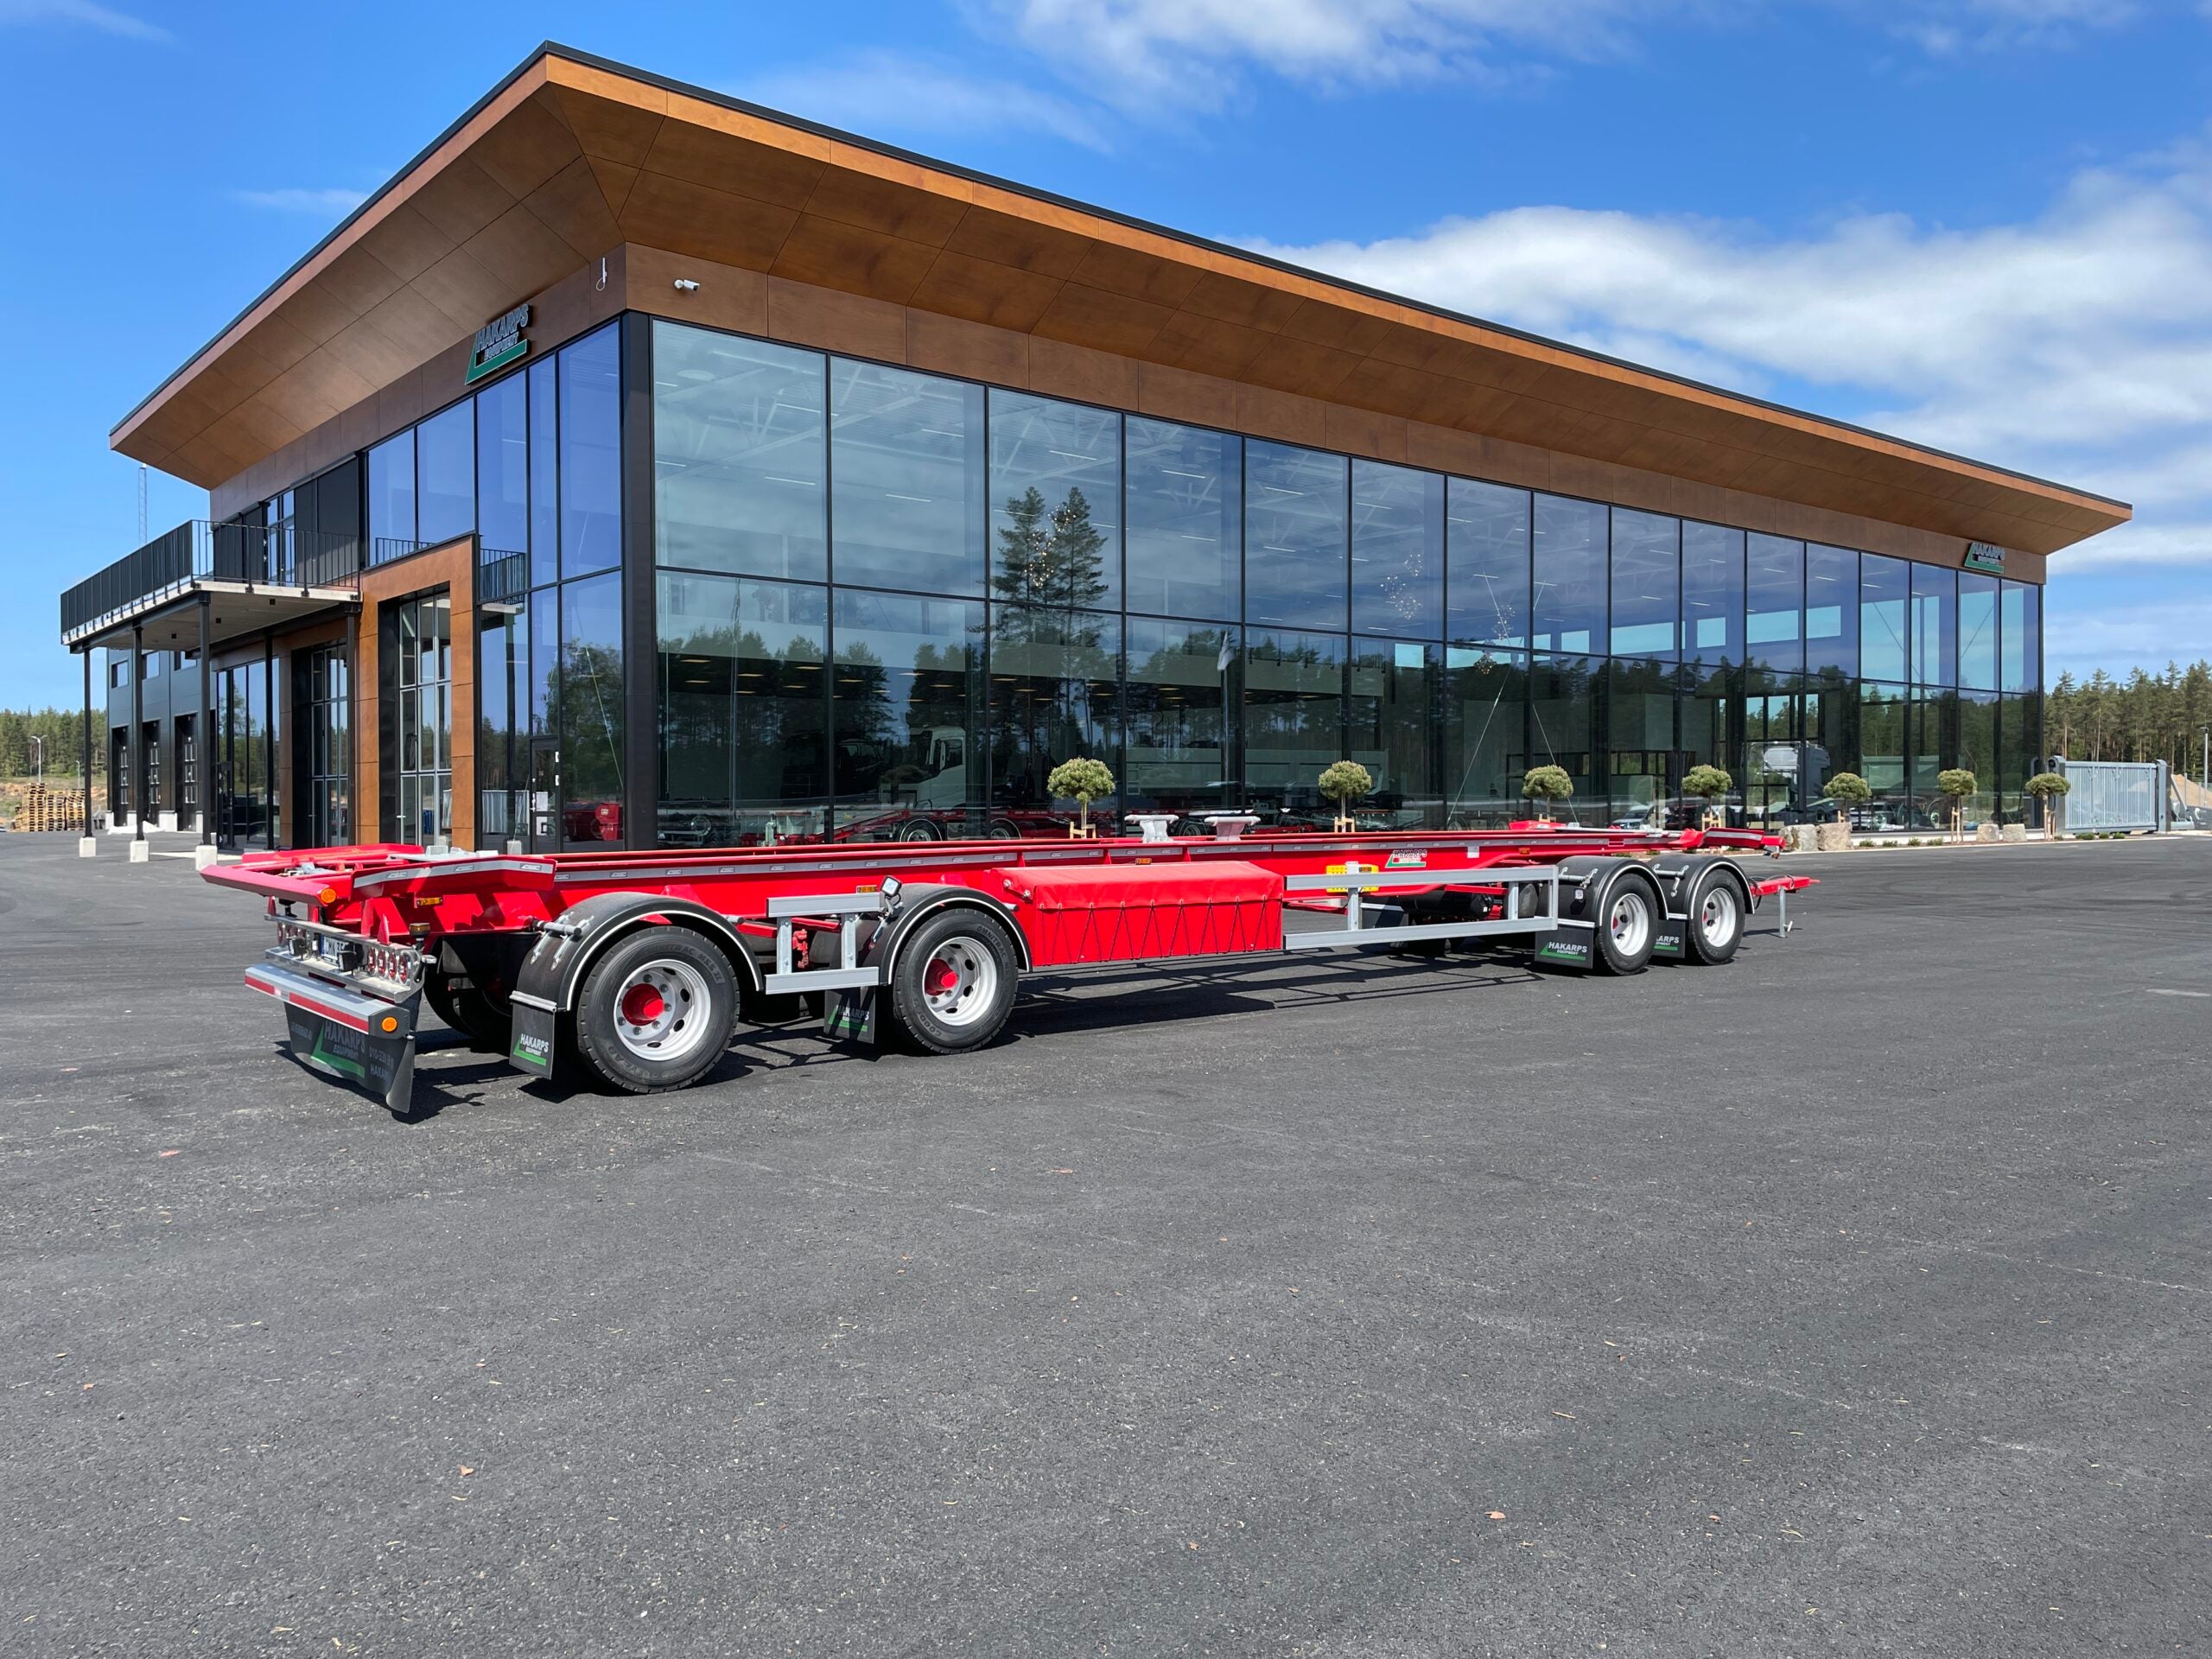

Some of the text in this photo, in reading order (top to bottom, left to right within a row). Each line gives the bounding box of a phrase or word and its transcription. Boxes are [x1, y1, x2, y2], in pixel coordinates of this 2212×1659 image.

[475, 303, 529, 353] HAKARPS
[1548, 941, 1588, 953] HAKARPS
[1656, 935, 1680, 944] ARPS
[323, 1020, 366, 1054] HAKARPS
[520, 1033, 550, 1053] HAKARPS
[333, 1044, 359, 1059] EQUIPMENT
